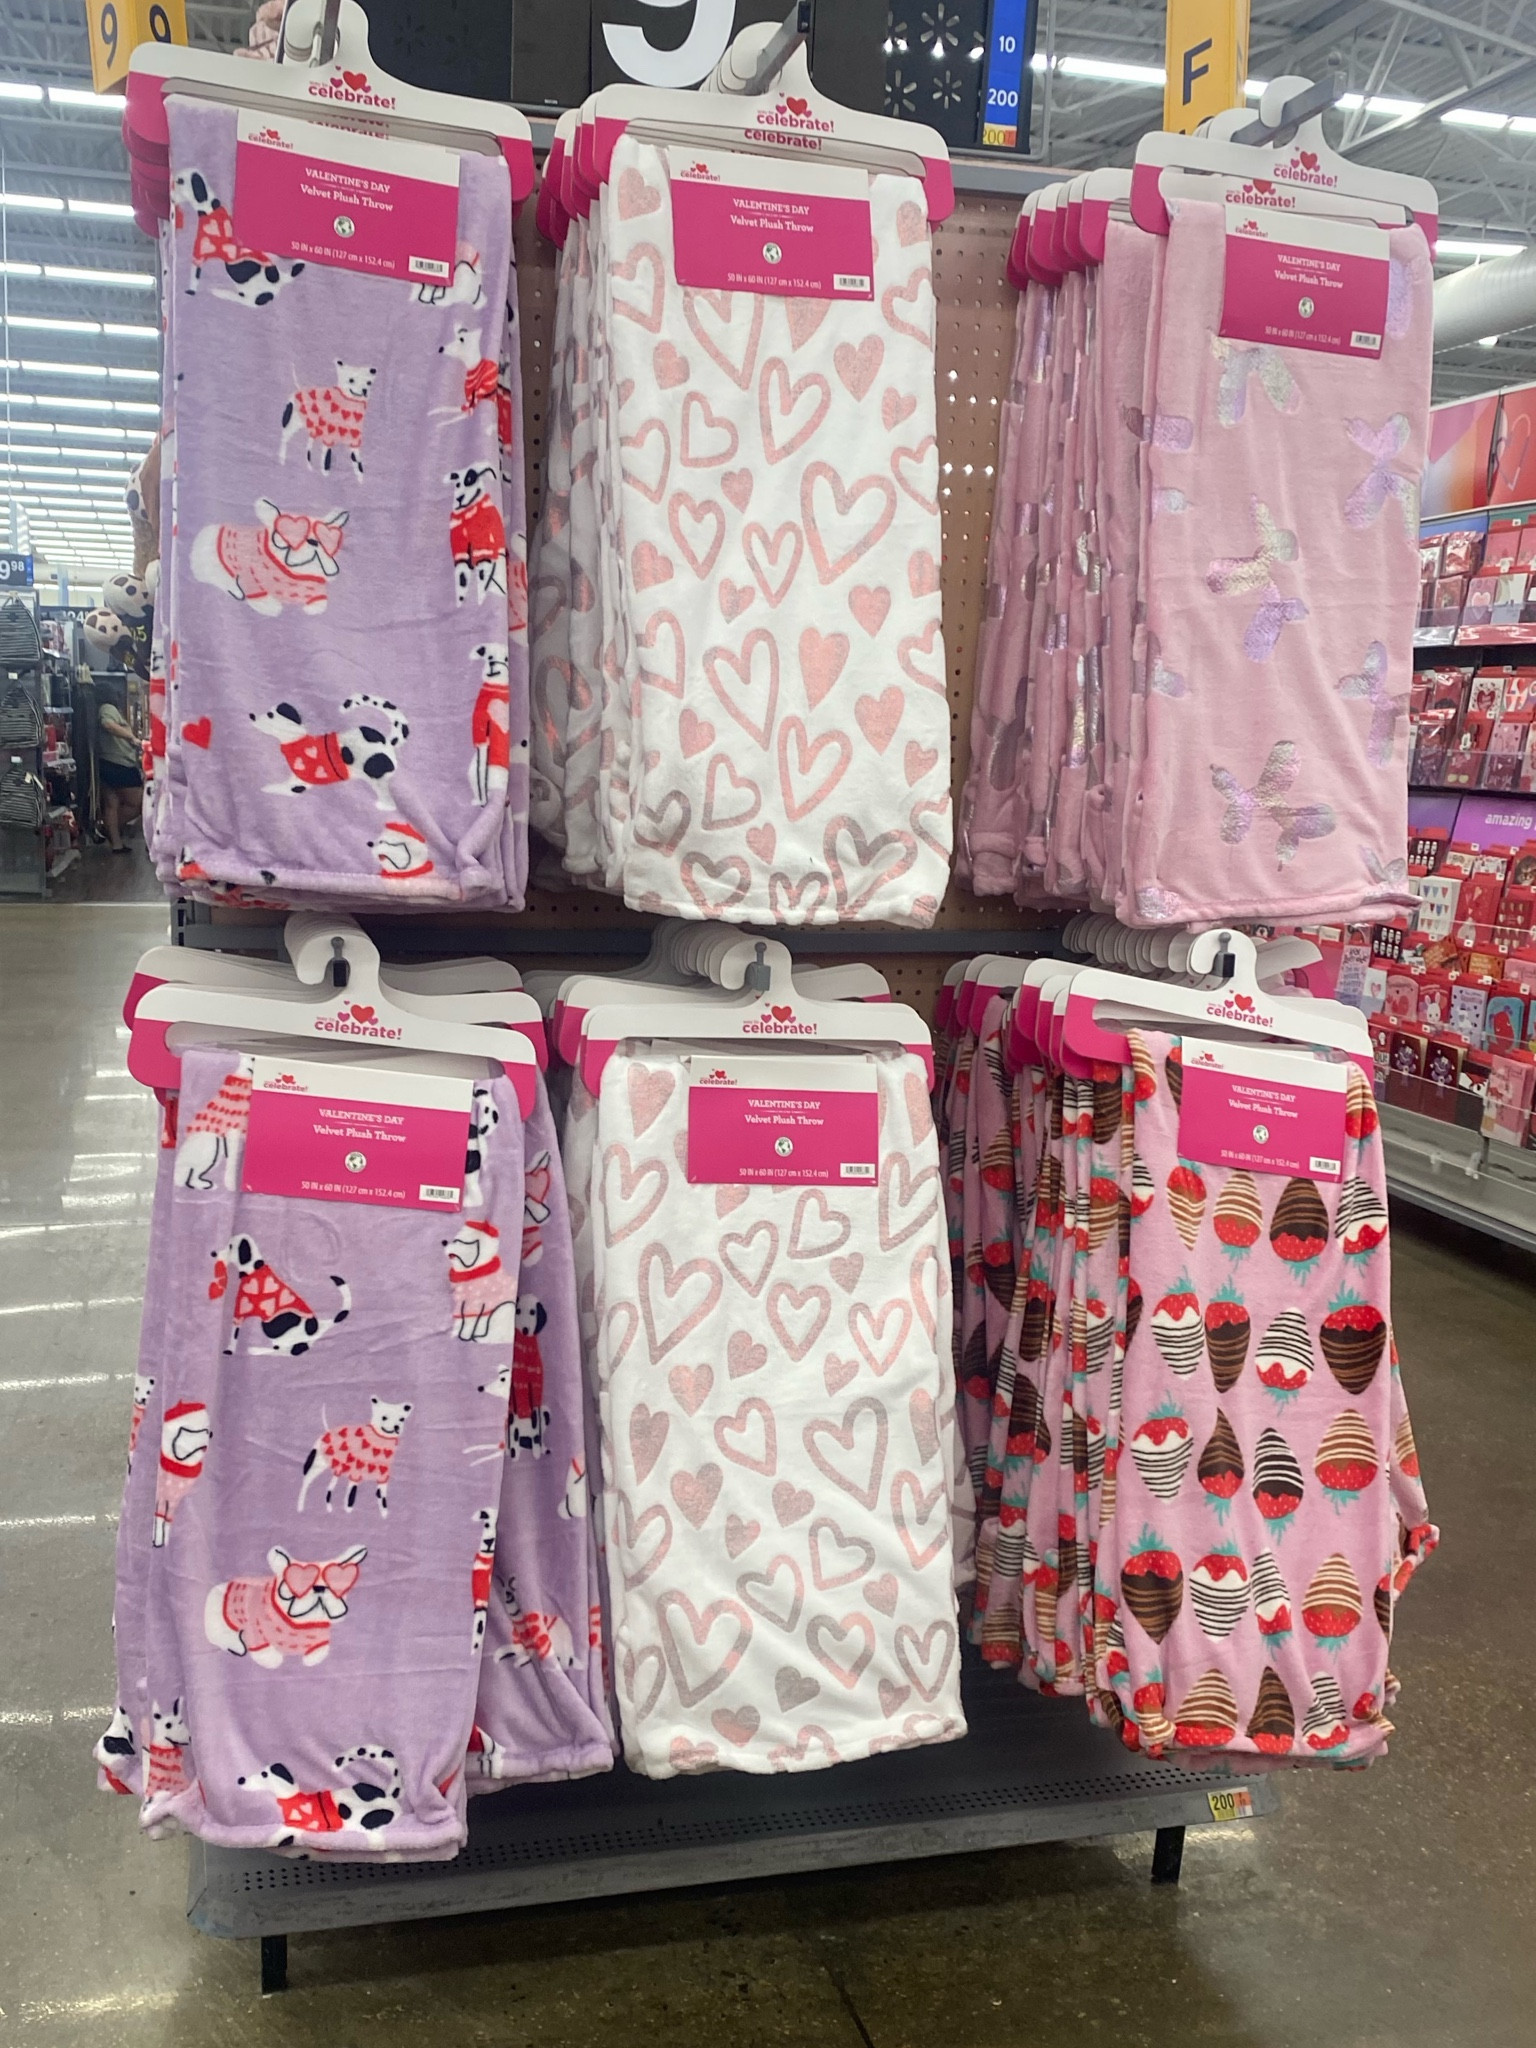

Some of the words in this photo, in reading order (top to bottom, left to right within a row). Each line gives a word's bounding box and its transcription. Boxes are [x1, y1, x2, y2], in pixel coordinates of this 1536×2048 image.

[101, 2, 118, 70] 9
[999, 35, 1016, 53] 10
[1183, 38, 1212, 106] F
[308, 85, 396, 110] celebrate!
[987, 88, 1018, 108] 200
[757, 113, 835, 133] celebrate!
[744, 128, 823, 151] celebrate!
[305, 168, 369, 190] VALENTINE'S
[370, 183, 390, 194] DAY
[1273, 167, 1338, 188] celebrate!
[301, 184, 331, 200] Velvet
[333, 190, 360, 205] Plush
[362, 197, 393, 211] Throw
[733, 198, 790, 213] VALENTINE'S
[792, 204, 810, 215] DAY
[1225, 192, 1296, 208] celebrate!
[730, 215, 758, 228] Velvet
[760, 218, 783, 230] Plush
[785, 220, 814, 232] Throw
[1278, 254, 1325, 269] VALENTINE'S
[1326, 262, 1341, 272] DAY
[1275, 270, 1297, 282] Velvet
[1299, 273, 1319, 285] Plush
[1320, 276, 1344, 288] Throw
[1485, 813, 1533, 830] amazing
[1206, 1006, 1273, 1028] celebrate!
[314, 1020, 403, 1040] celebrate!
[742, 1022, 817, 1035] celebrate!
[748, 1099, 803, 1109] VALENTINE'S
[804, 1101, 821, 1110] DAY
[1280, 1093, 1296, 1103] DAY
[319, 1108, 382, 1122] VALENTINE'S
[384, 1116, 404, 1125] DAY
[744, 1114, 772, 1124] Velvet
[773, 1115, 796, 1125] Plush
[797, 1116, 824, 1126] Throw
[313, 1124, 344, 1137] Velvet
[346, 1128, 372, 1140] Plush
[374, 1131, 406, 1142] Throw
[1212, 1793, 1235, 1811] 200
